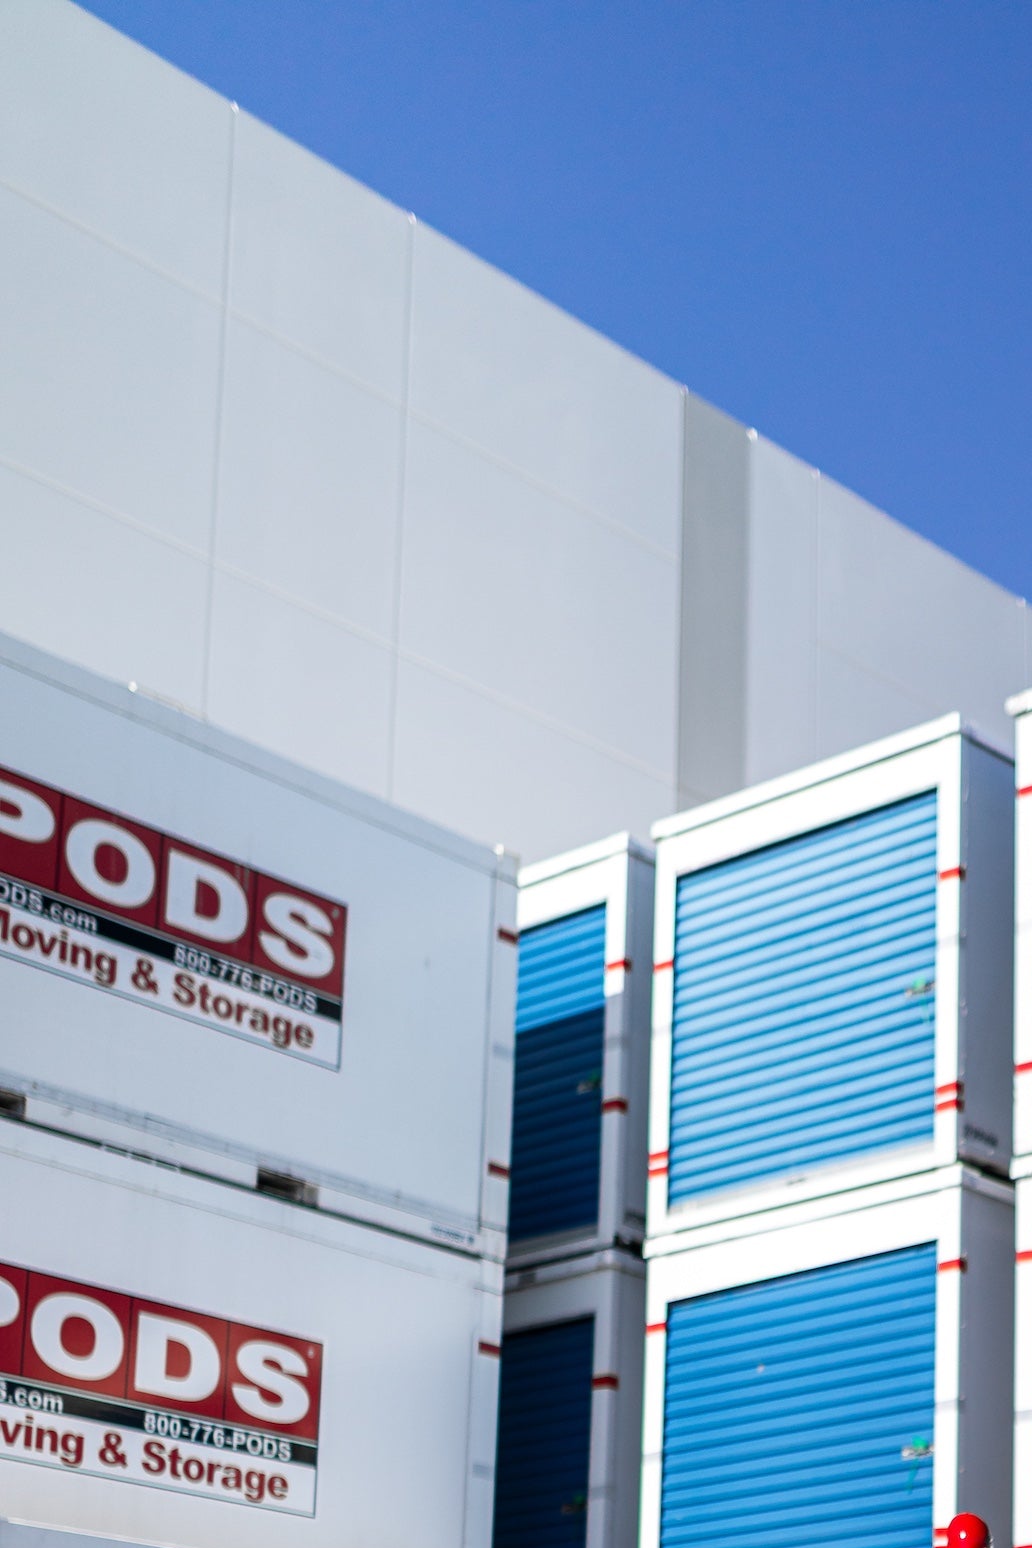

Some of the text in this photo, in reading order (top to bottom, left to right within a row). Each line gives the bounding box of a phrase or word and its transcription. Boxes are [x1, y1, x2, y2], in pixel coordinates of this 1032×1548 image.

[131, 957, 159, 994] &
[173, 971, 314, 1048] Storage
[0, 1275, 310, 1424] ODS
[0, 1414, 289, 1503] ving & Storage
[144, 1412, 291, 1462] 800-776-PODS
